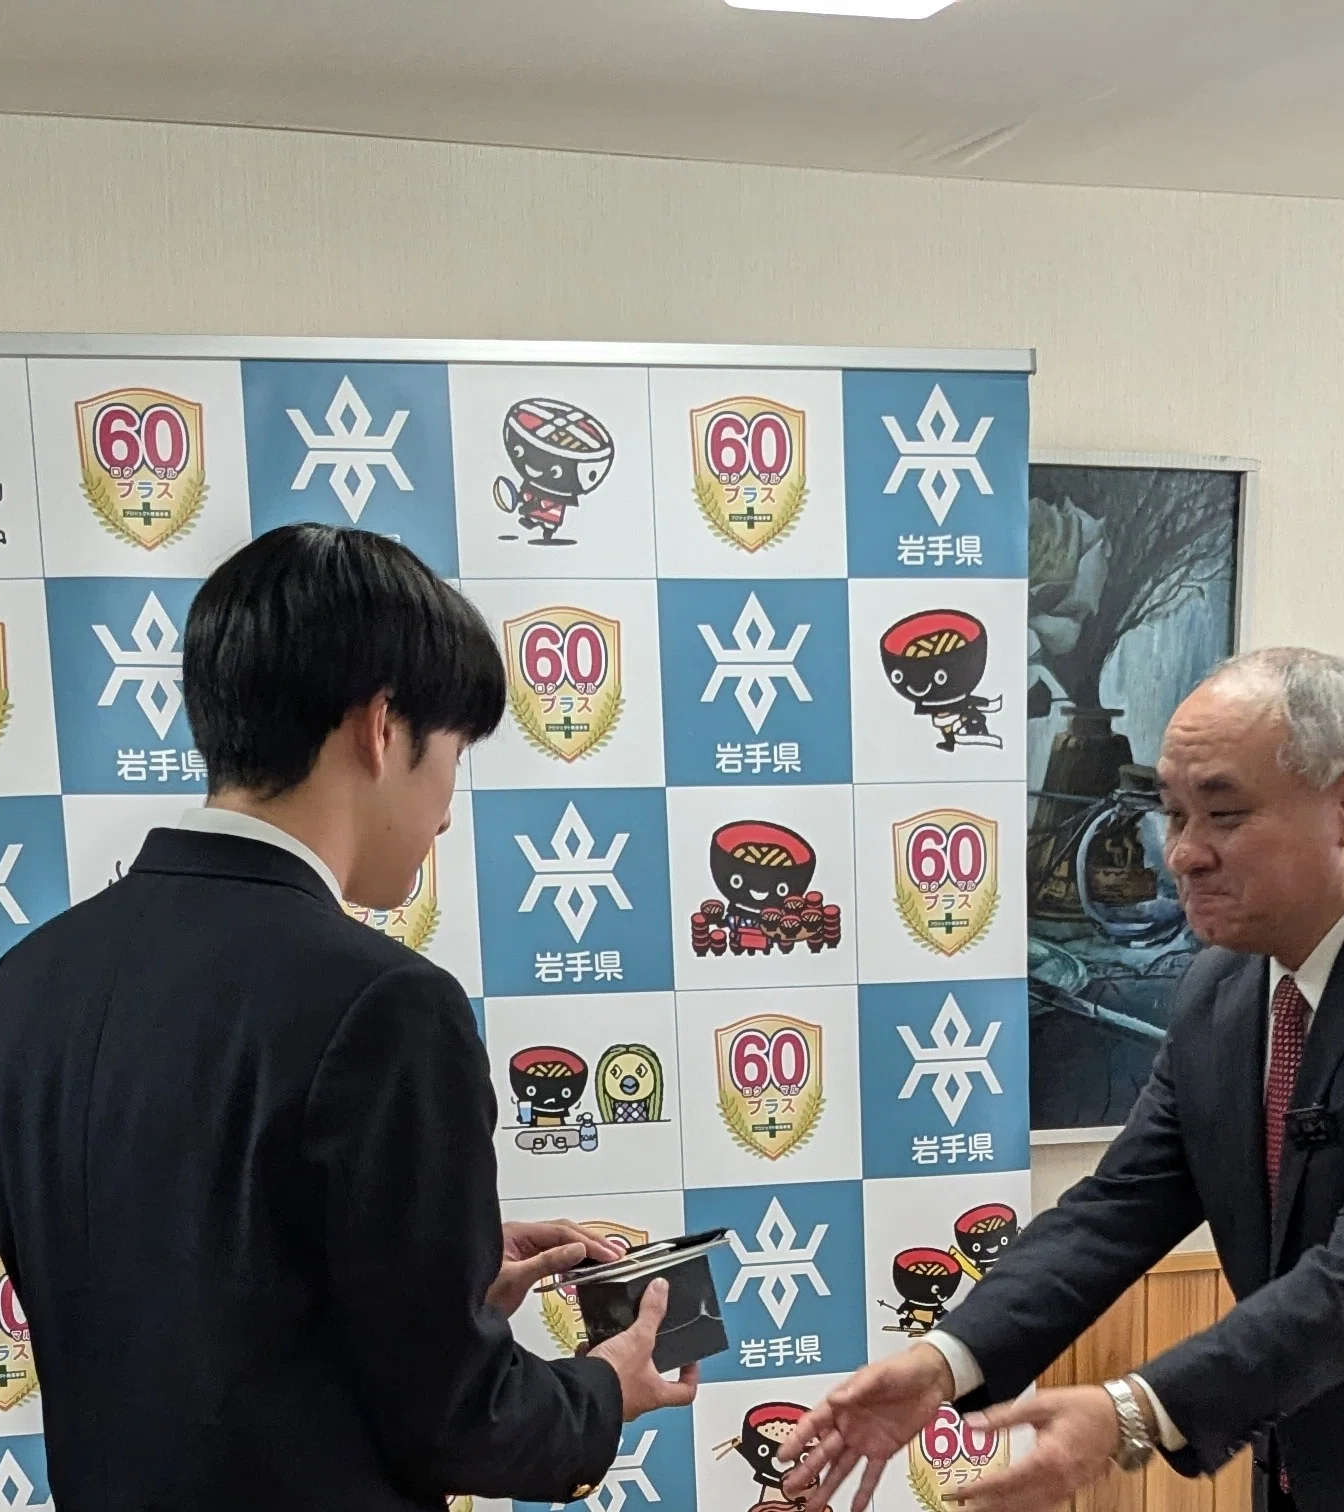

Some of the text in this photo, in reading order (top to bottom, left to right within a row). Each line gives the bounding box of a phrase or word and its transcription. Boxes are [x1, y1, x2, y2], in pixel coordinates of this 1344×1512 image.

[95, 405, 187, 473] 60
[708, 414, 788, 476] 60
[117, 481, 173, 499] プラス
[725, 487, 775, 503] プラス
[897, 535, 983, 566] 岩手県
[520, 624, 605, 689] 60
[540, 697, 591, 713] プラス
[116, 749, 208, 782] 岩手県
[716, 742, 801, 773] 岩手県
[907, 825, 985, 887] 60
[923, 894, 972, 911] プラス
[534, 951, 624, 983] 岩手県
[731, 1031, 808, 1089] 60
[748, 1098, 795, 1115] プラス
[912, 1133, 994, 1165] 岩手県
[739, 1335, 822, 1368] 岩手県
